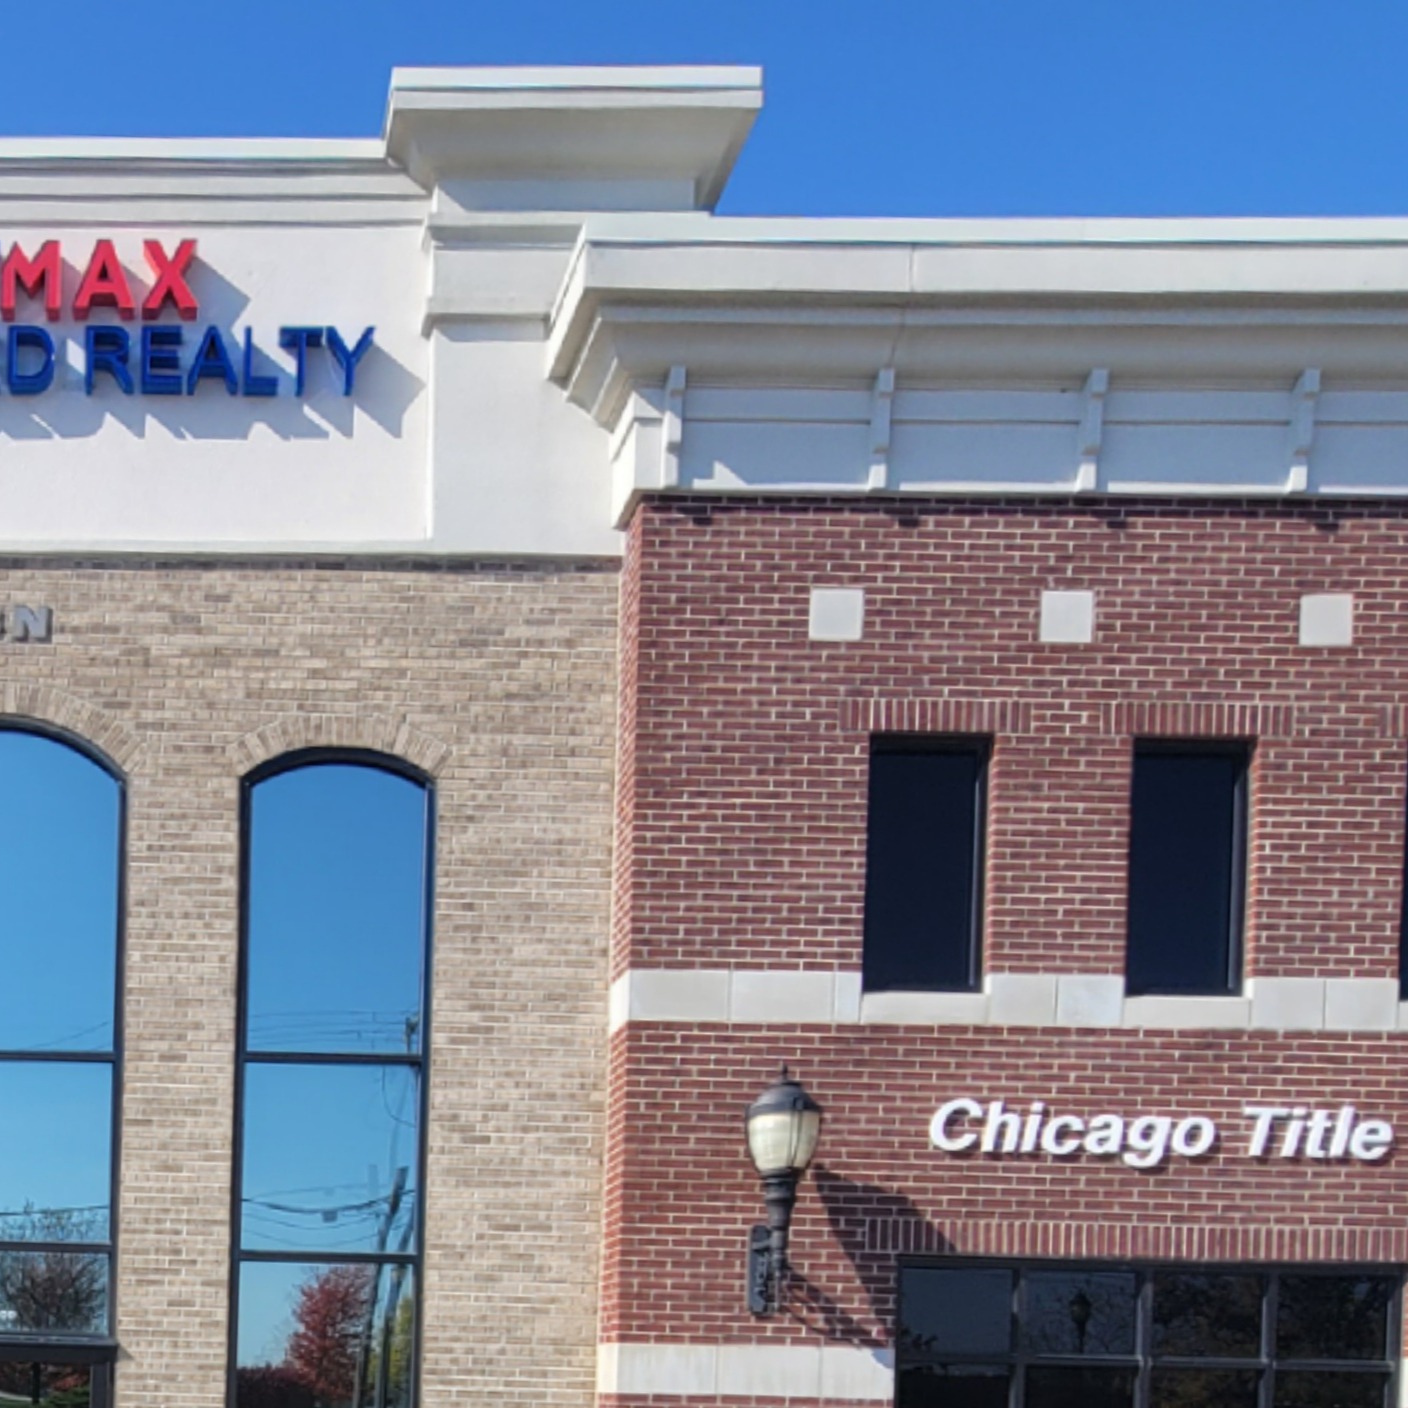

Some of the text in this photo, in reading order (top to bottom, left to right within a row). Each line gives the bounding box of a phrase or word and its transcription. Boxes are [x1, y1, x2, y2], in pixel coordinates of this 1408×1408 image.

[84, 325, 376, 396] REALTY
[13, 604, 53, 643] N
[929, 1098, 1393, 1168] Chicago Title
